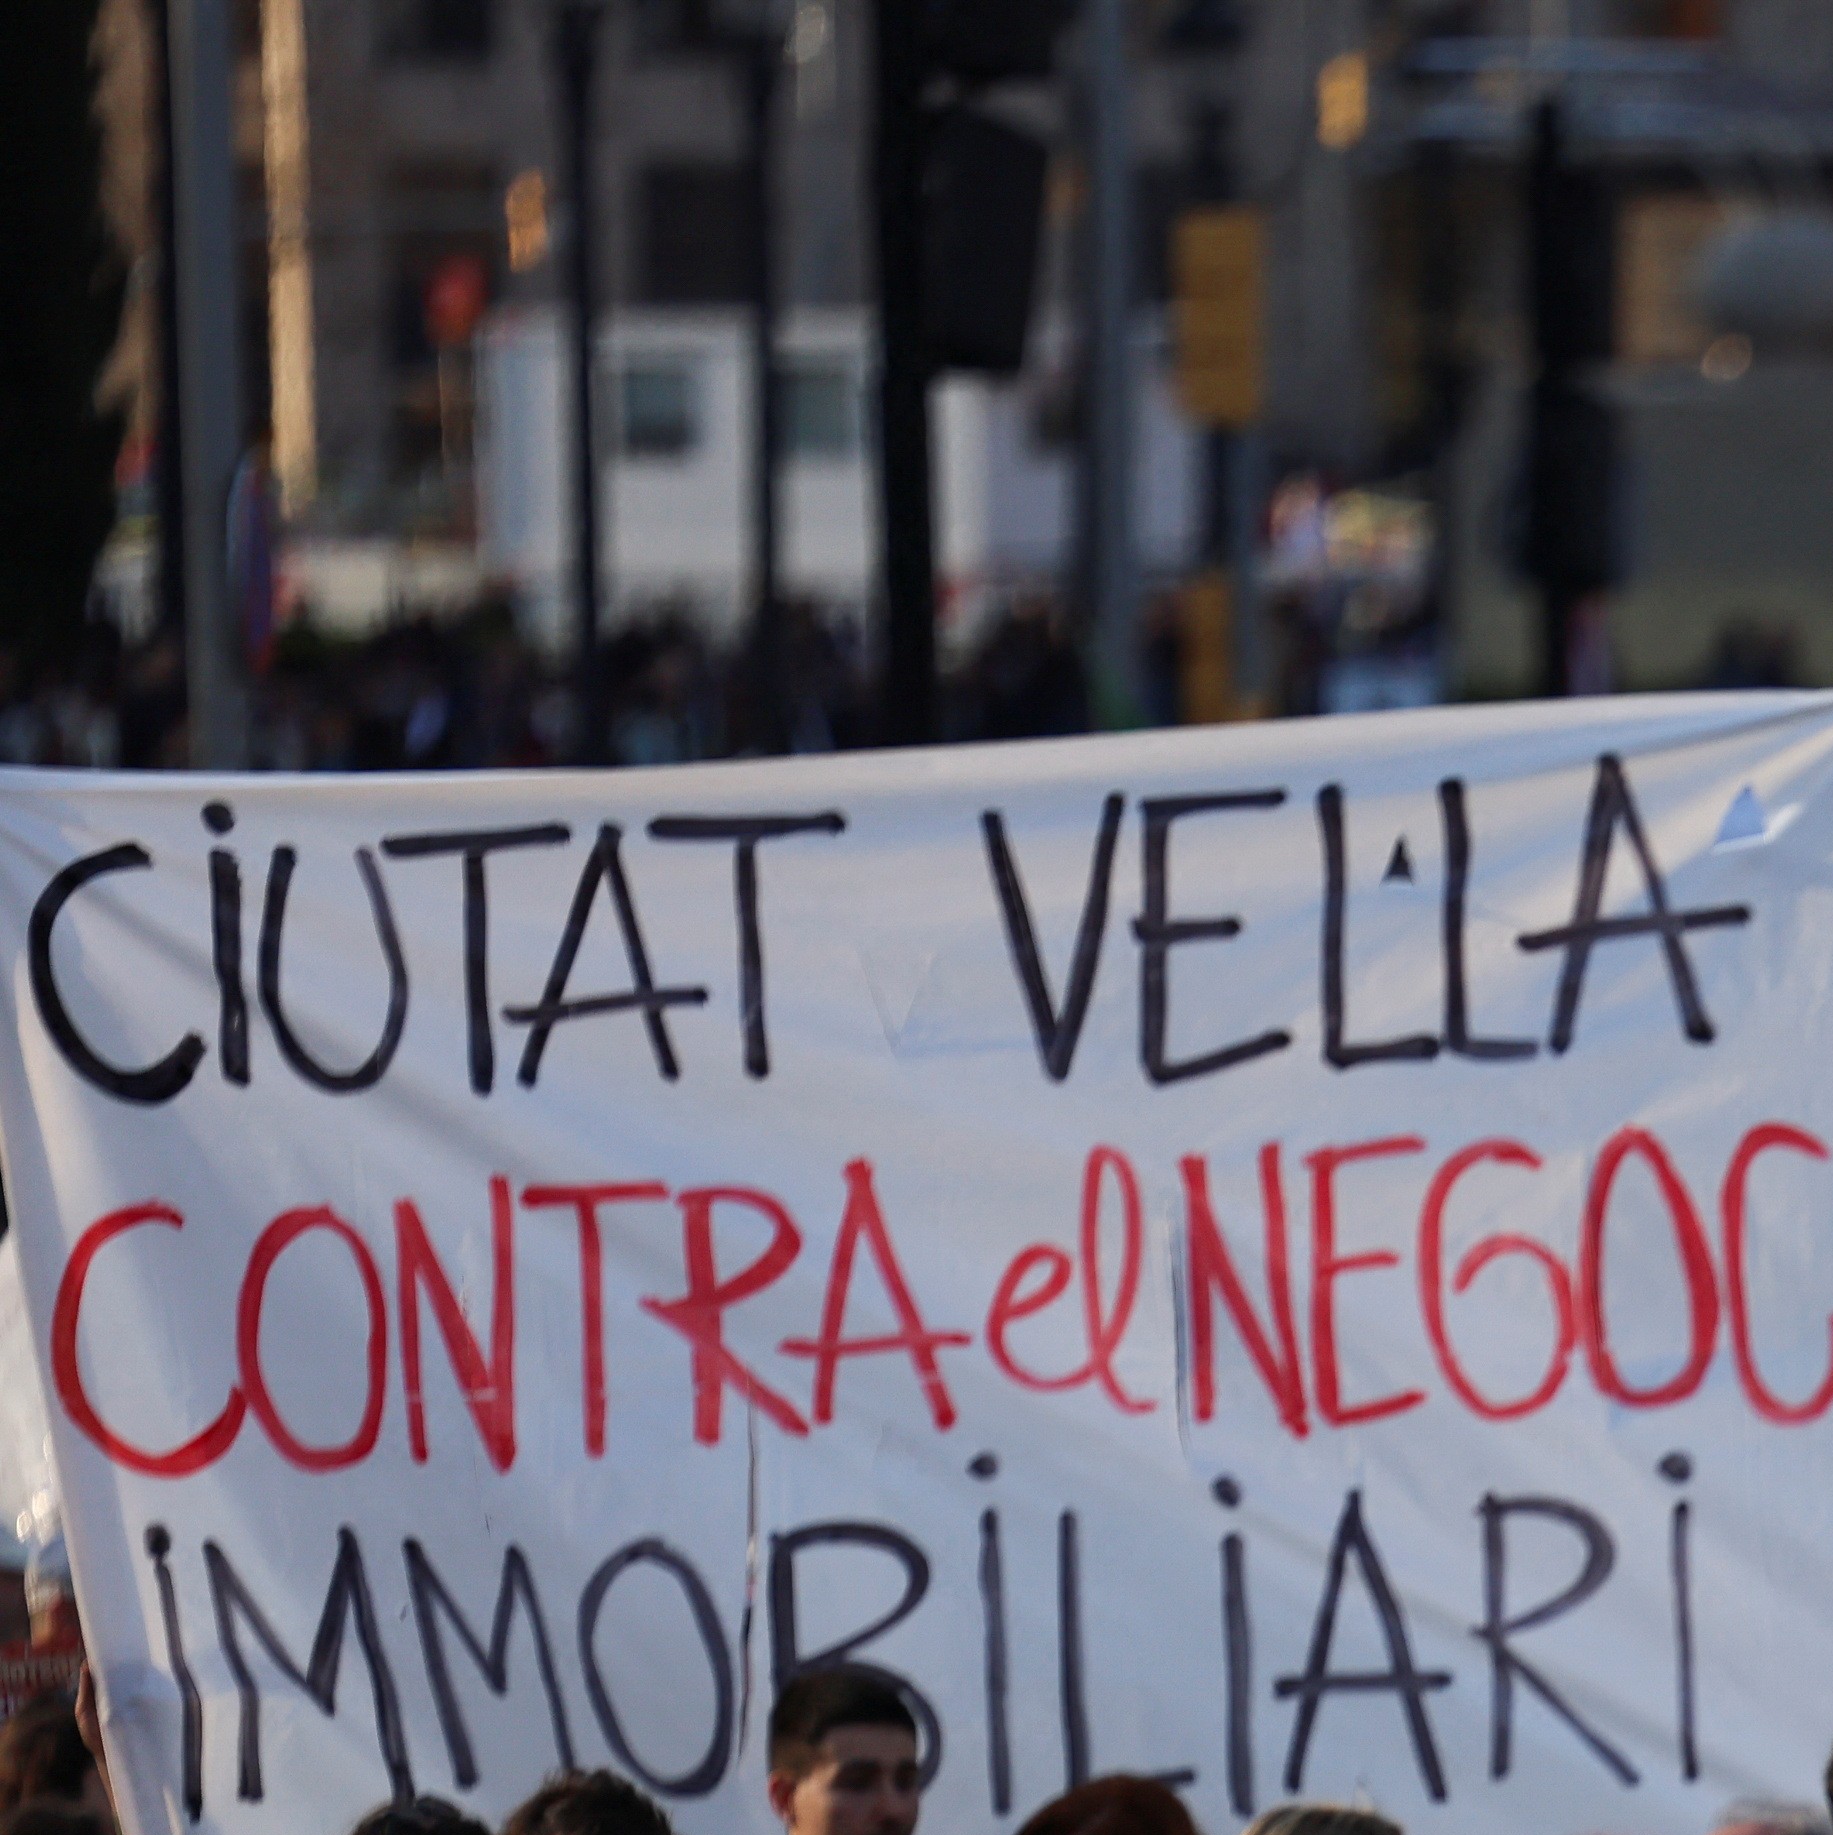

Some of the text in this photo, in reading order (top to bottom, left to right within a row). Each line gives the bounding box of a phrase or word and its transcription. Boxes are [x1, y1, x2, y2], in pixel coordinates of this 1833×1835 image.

[29, 801, 845, 1104] CIUTAT
[51, 1158, 970, 1478] CONTRA
[986, 1143, 1157, 1415] el
